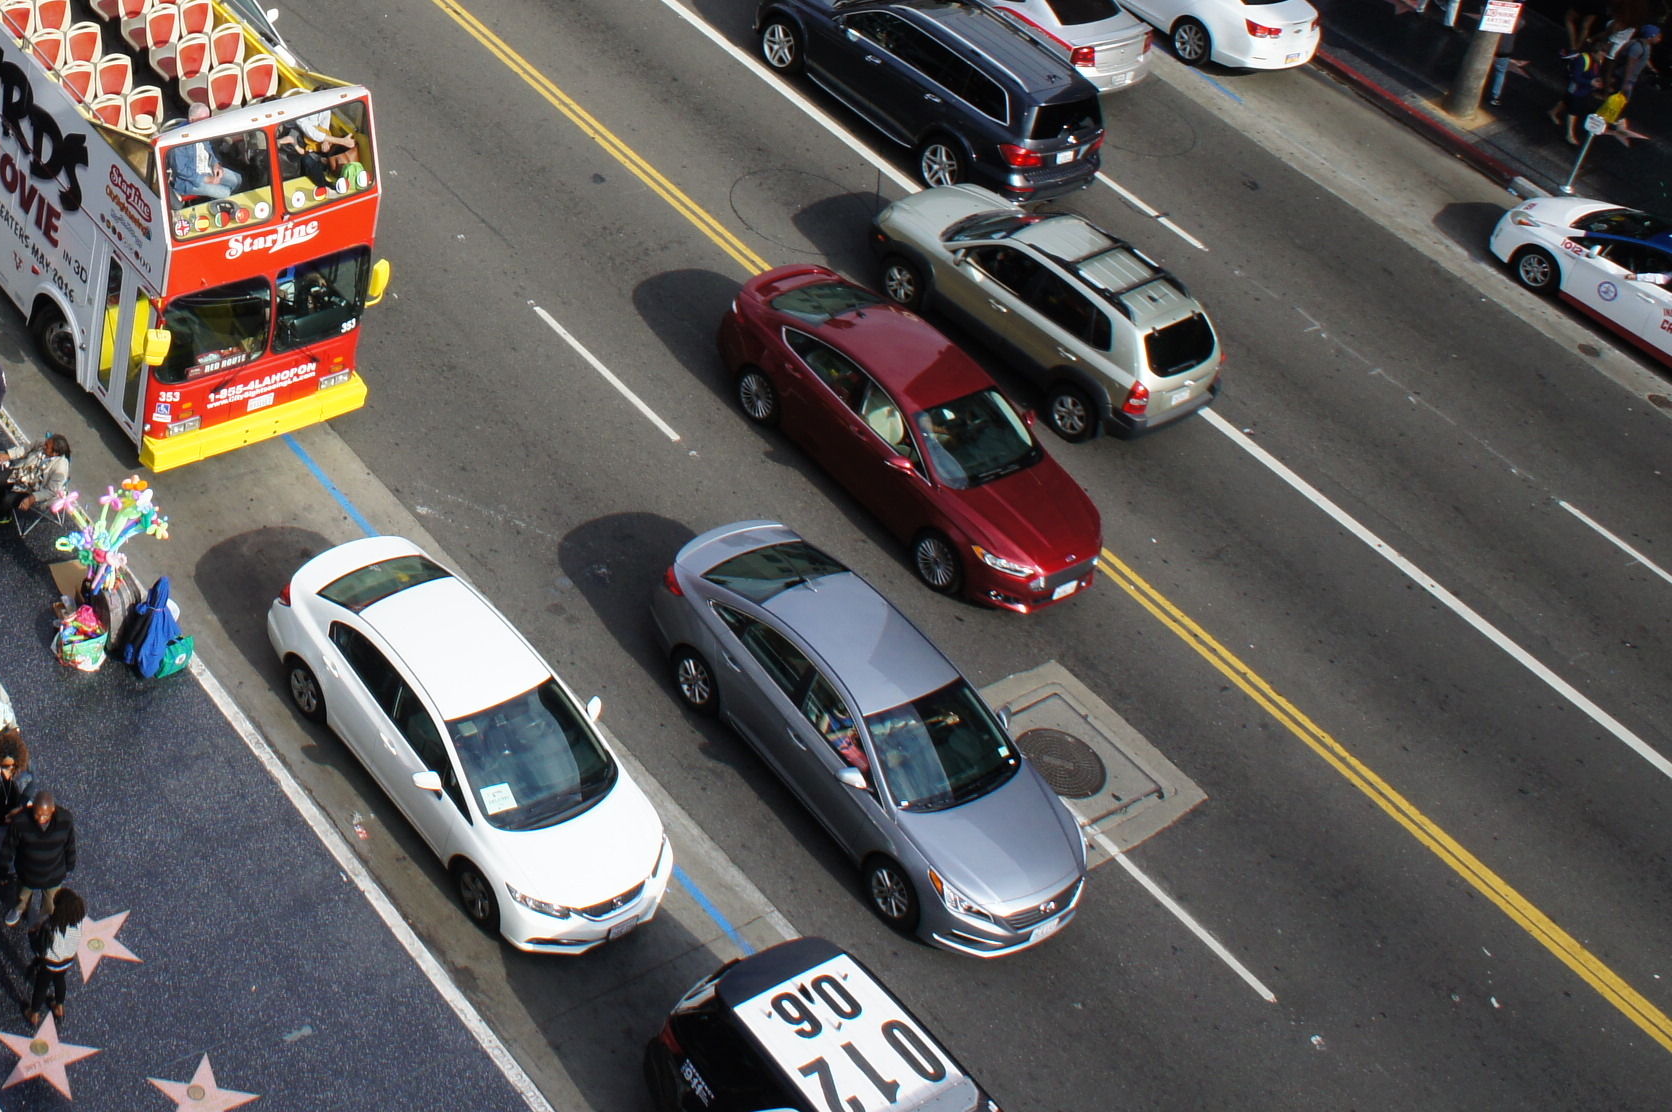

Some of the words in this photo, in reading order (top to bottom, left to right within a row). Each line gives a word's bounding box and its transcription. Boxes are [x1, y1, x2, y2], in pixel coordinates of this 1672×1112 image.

[1561, 239, 1583, 256] 1012
[32, 243, 51, 273] MAY
[53, 269, 75, 304] 2016
[63, 249, 71, 266] IN
[73, 260, 88, 284] 3D
[340, 319, 356, 333] 353
[204, 361, 221, 373] RED
[223, 354, 247, 367] ROUTE
[159, 391, 180, 402] 353
